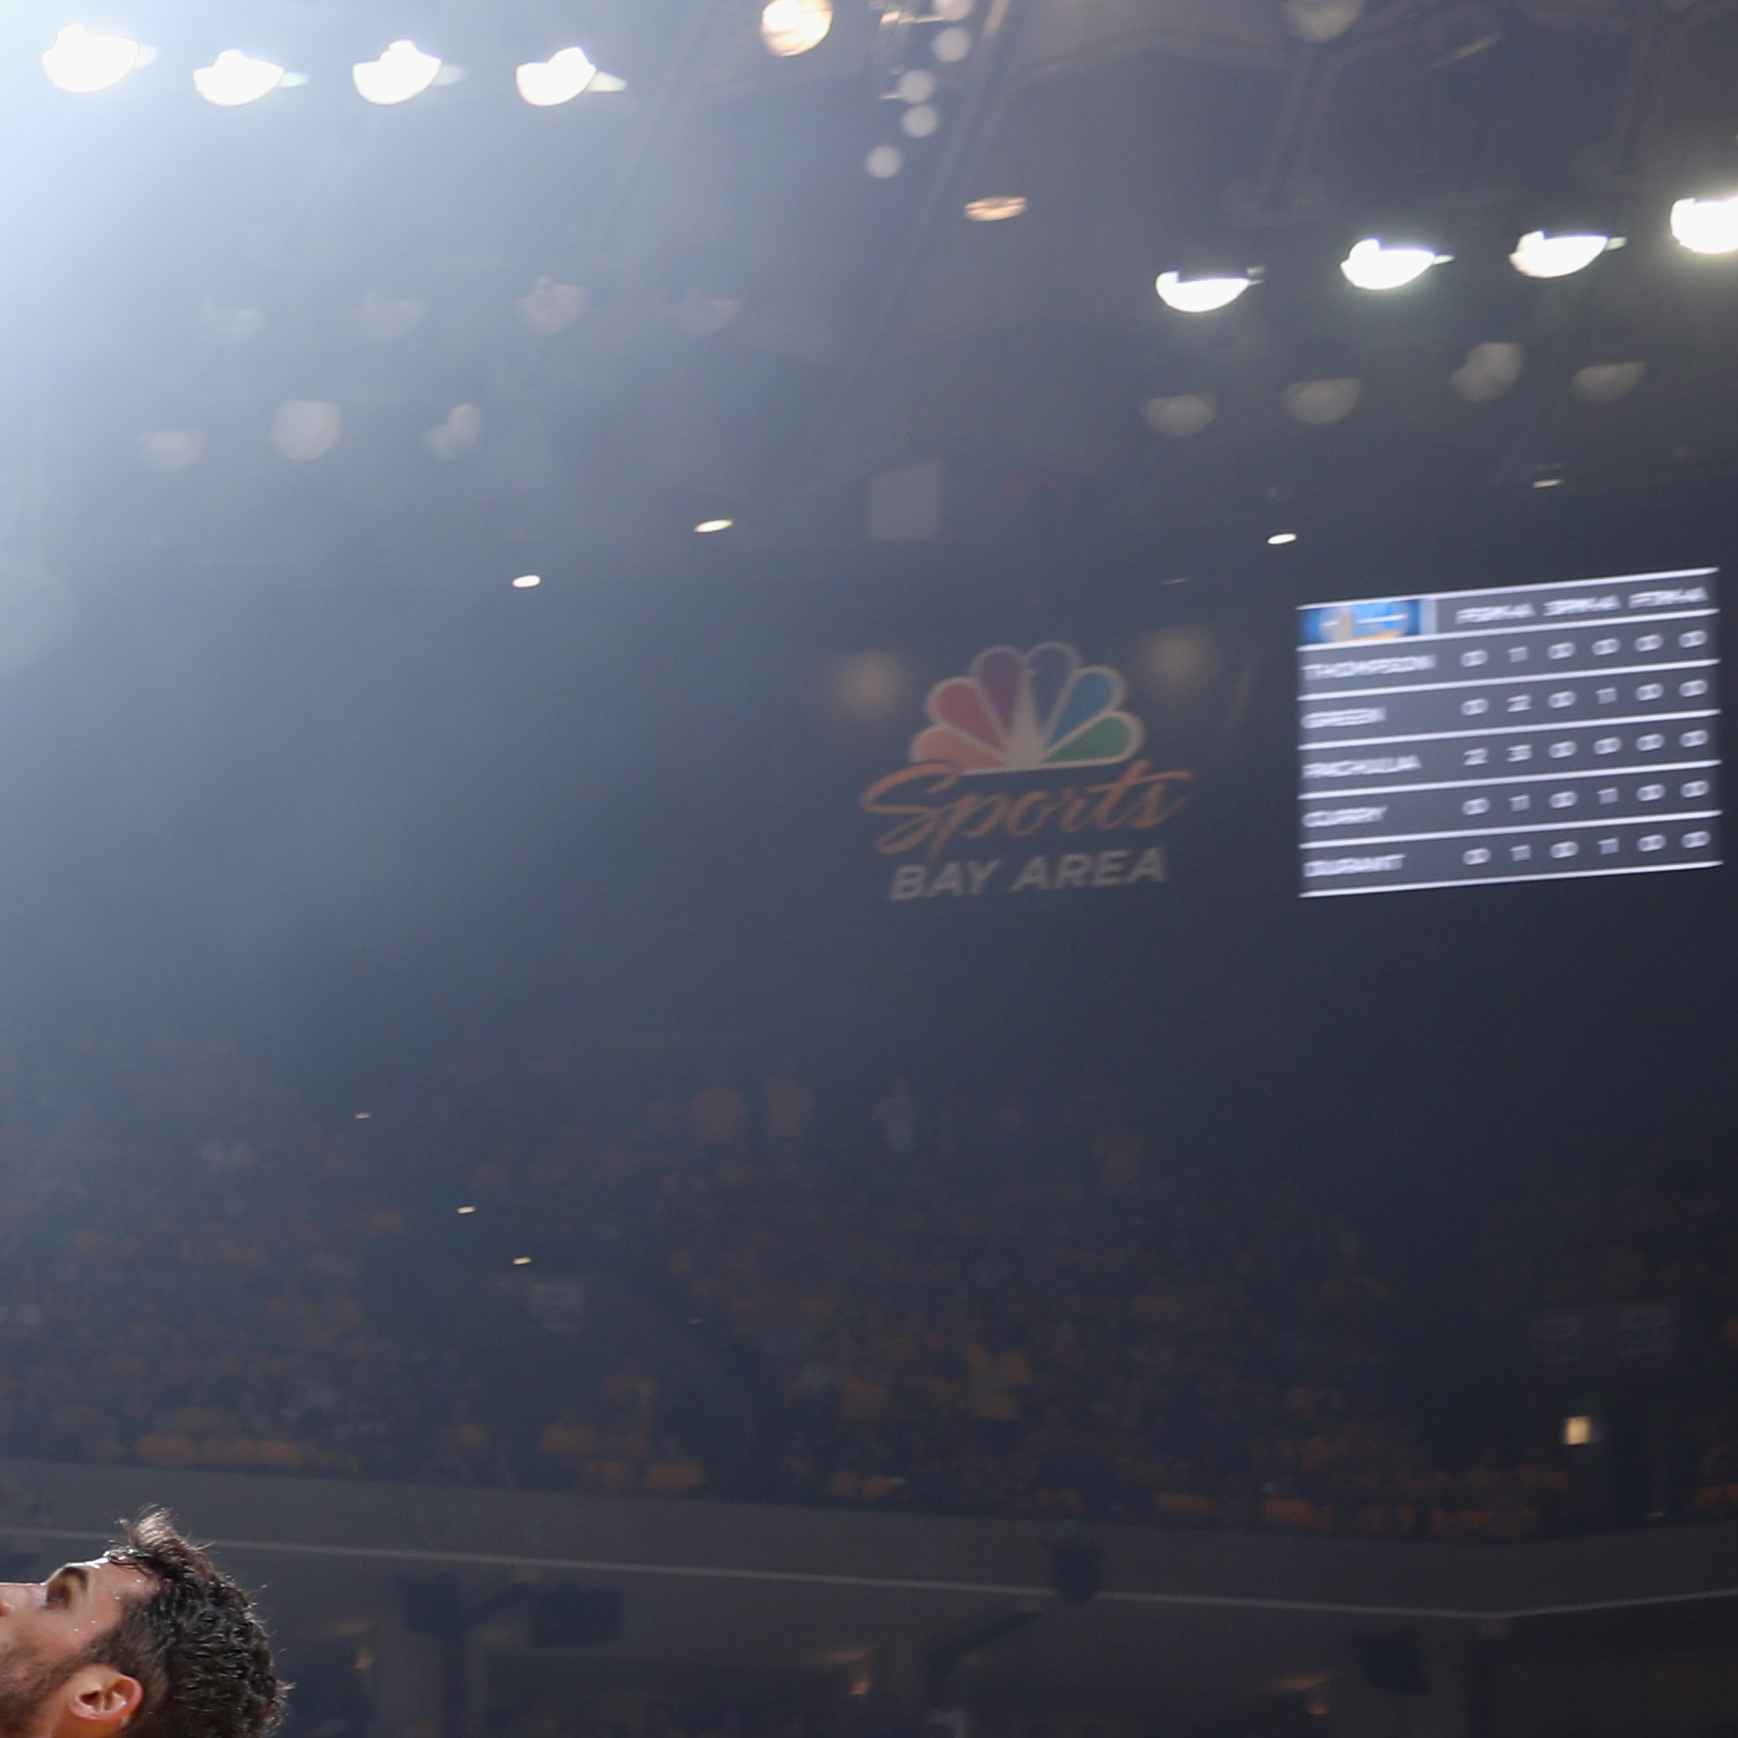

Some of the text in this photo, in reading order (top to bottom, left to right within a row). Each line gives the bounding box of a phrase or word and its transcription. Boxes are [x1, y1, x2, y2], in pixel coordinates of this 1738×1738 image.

[861, 758, 1194, 861] Sports
[890, 847, 1166, 900] BAY AREA
